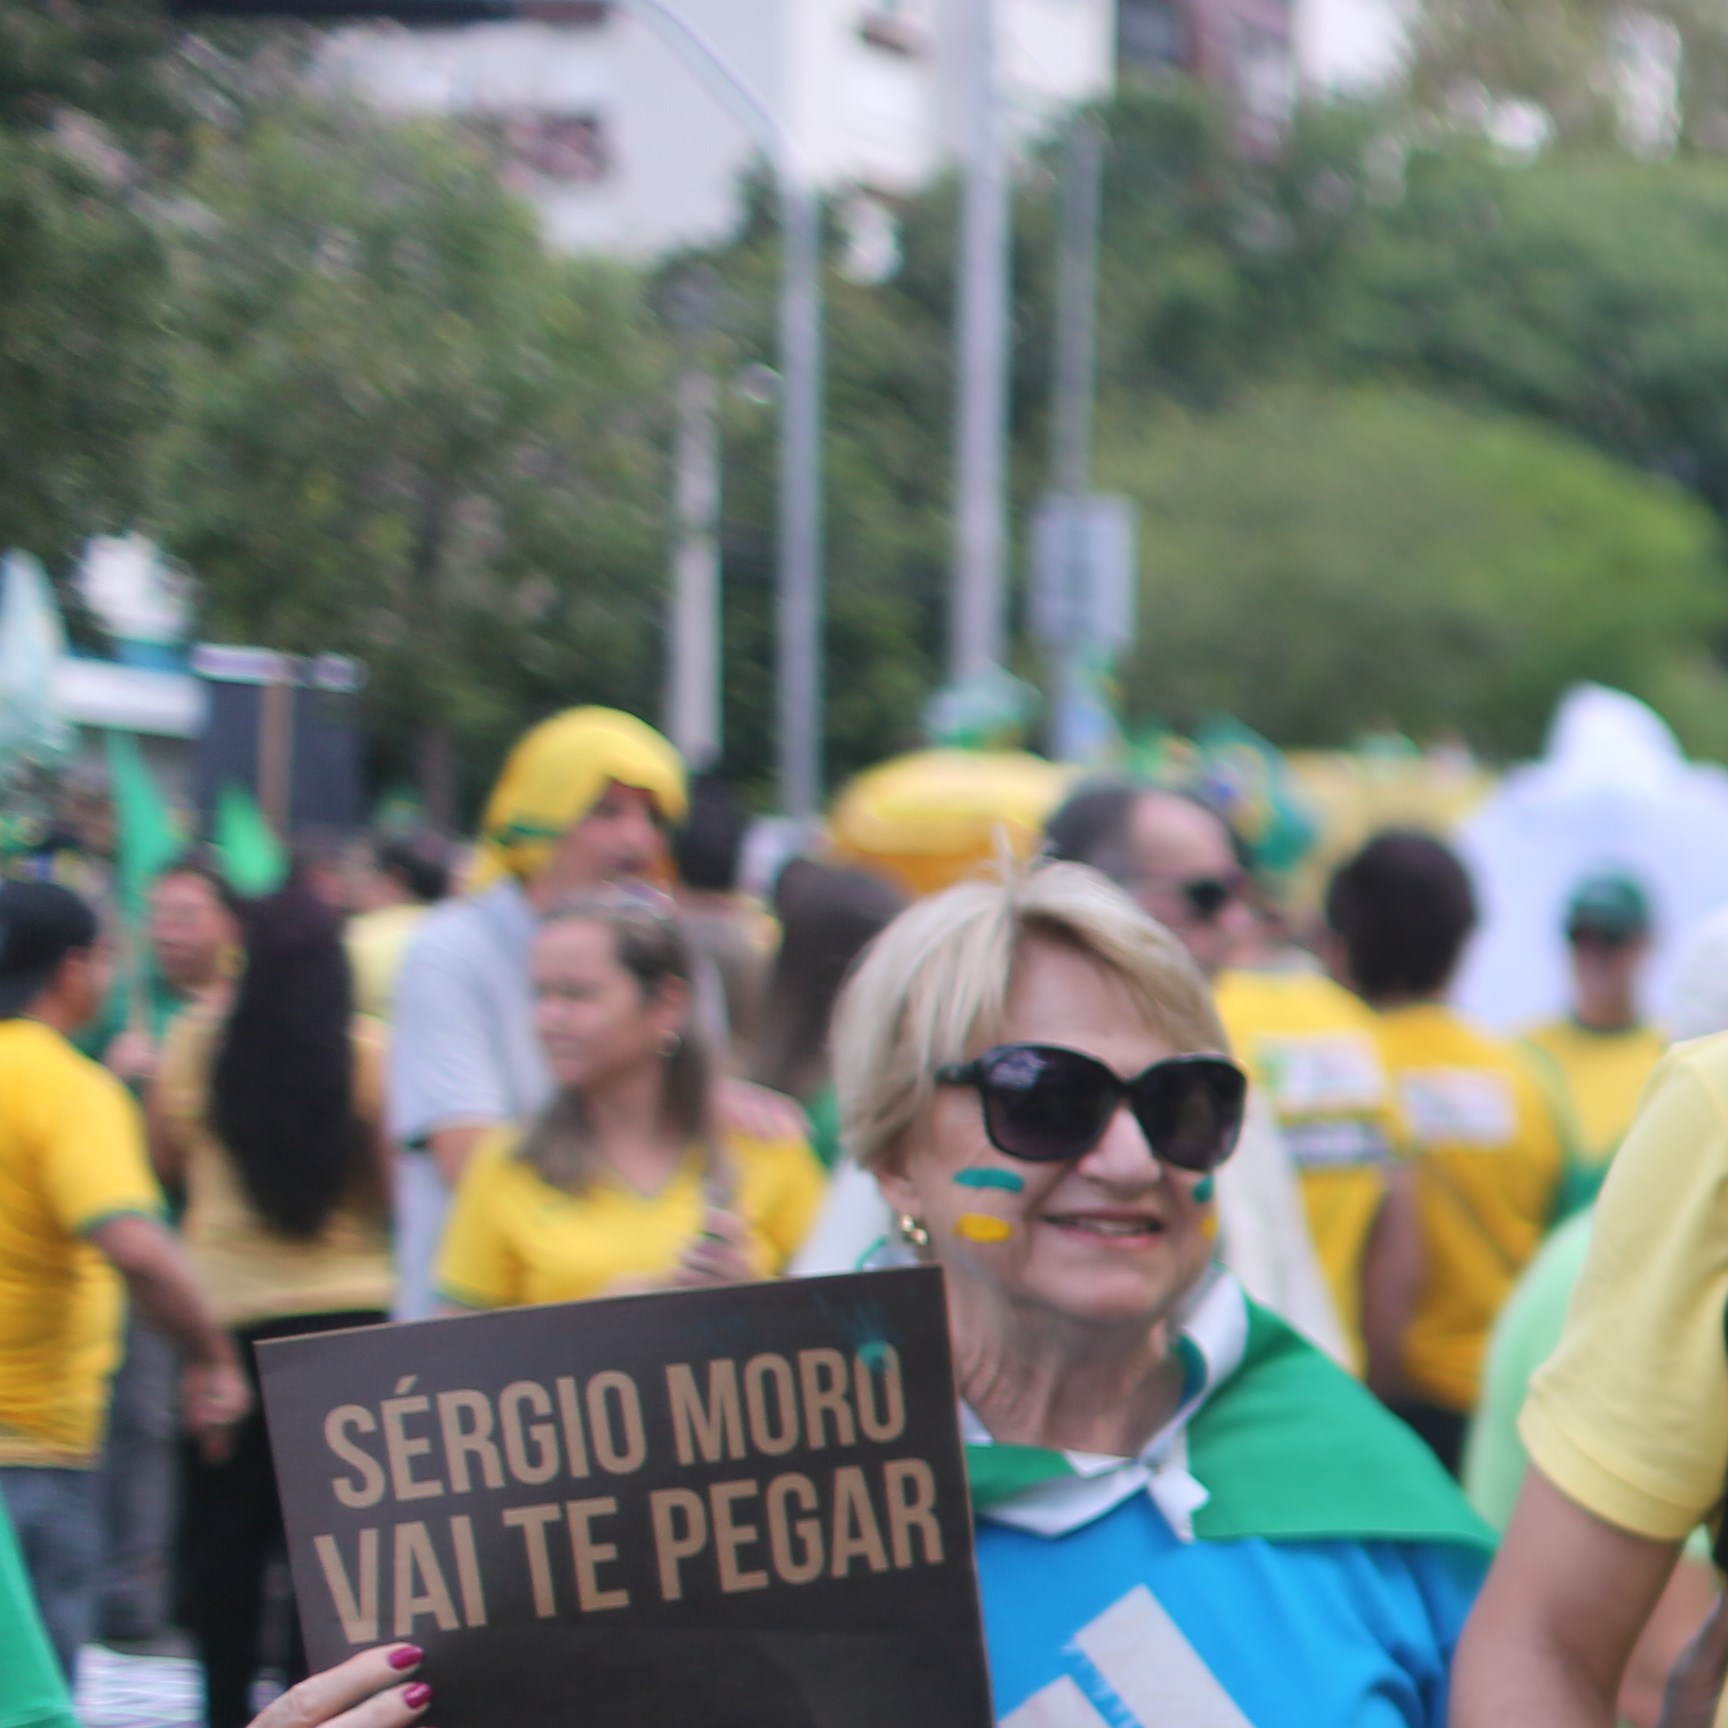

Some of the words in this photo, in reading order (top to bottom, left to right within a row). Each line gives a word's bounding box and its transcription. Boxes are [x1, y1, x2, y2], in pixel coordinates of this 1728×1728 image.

[323, 1368, 648, 1511] SÉRGIO
[664, 1340, 906, 1466] MORO
[313, 1514, 490, 1647] VAI
[502, 1496, 630, 1619] TE
[648, 1457, 945, 1602] PEGAR
